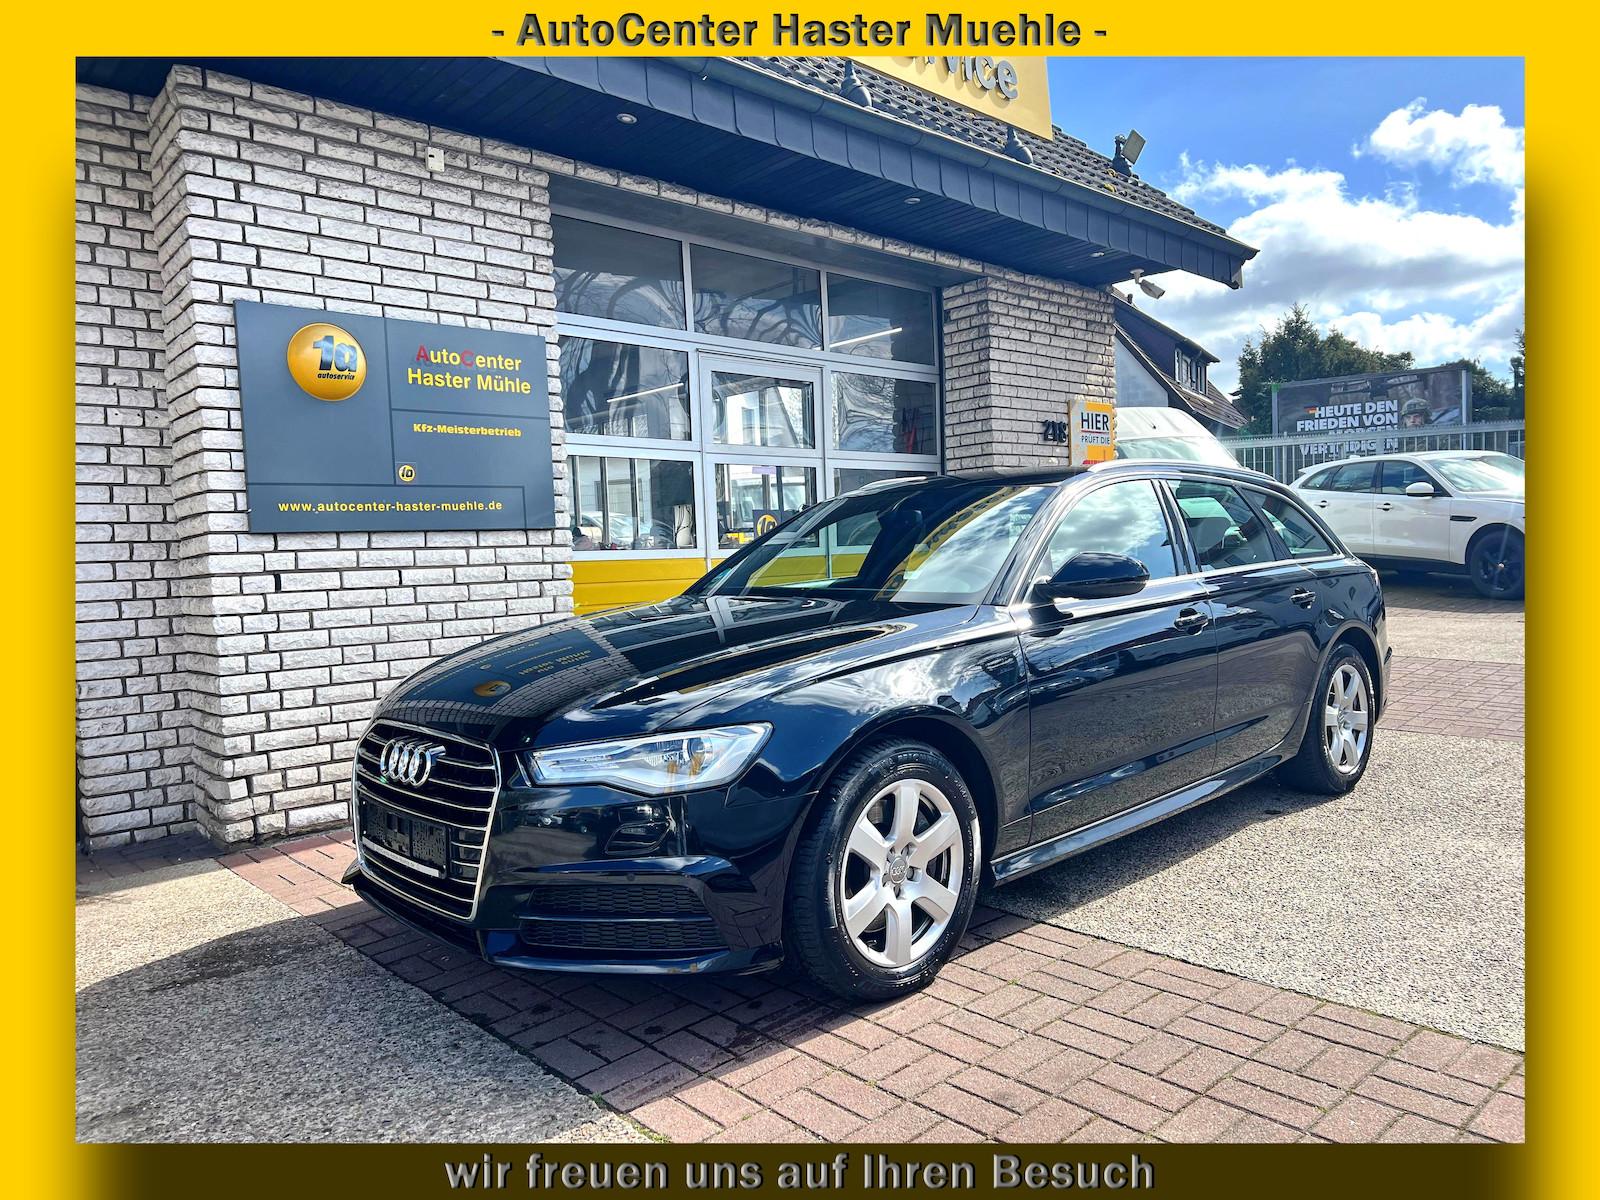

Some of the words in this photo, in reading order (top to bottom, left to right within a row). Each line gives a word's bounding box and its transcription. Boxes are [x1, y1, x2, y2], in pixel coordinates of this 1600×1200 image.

[415, 344, 522, 371] AutoCenter
[407, 367, 471, 389] Haster
[476, 373, 531, 394] Mühle
[1315, 402, 1362, 418] HEUTE
[1365, 400, 1398, 414] DEN
[413, 423, 522, 437] Kfz-Meisterbetrieb
[1080, 412, 1110, 431] HIER
[1296, 416, 1360, 432] FRIEDEN
[1362, 412, 1398, 427] VON
[1081, 434, 1099, 445] PRÜFT
[1100, 436, 1111, 445] DIE
[278, 500, 503, 512] www.autocenter-haster-muehle.de
